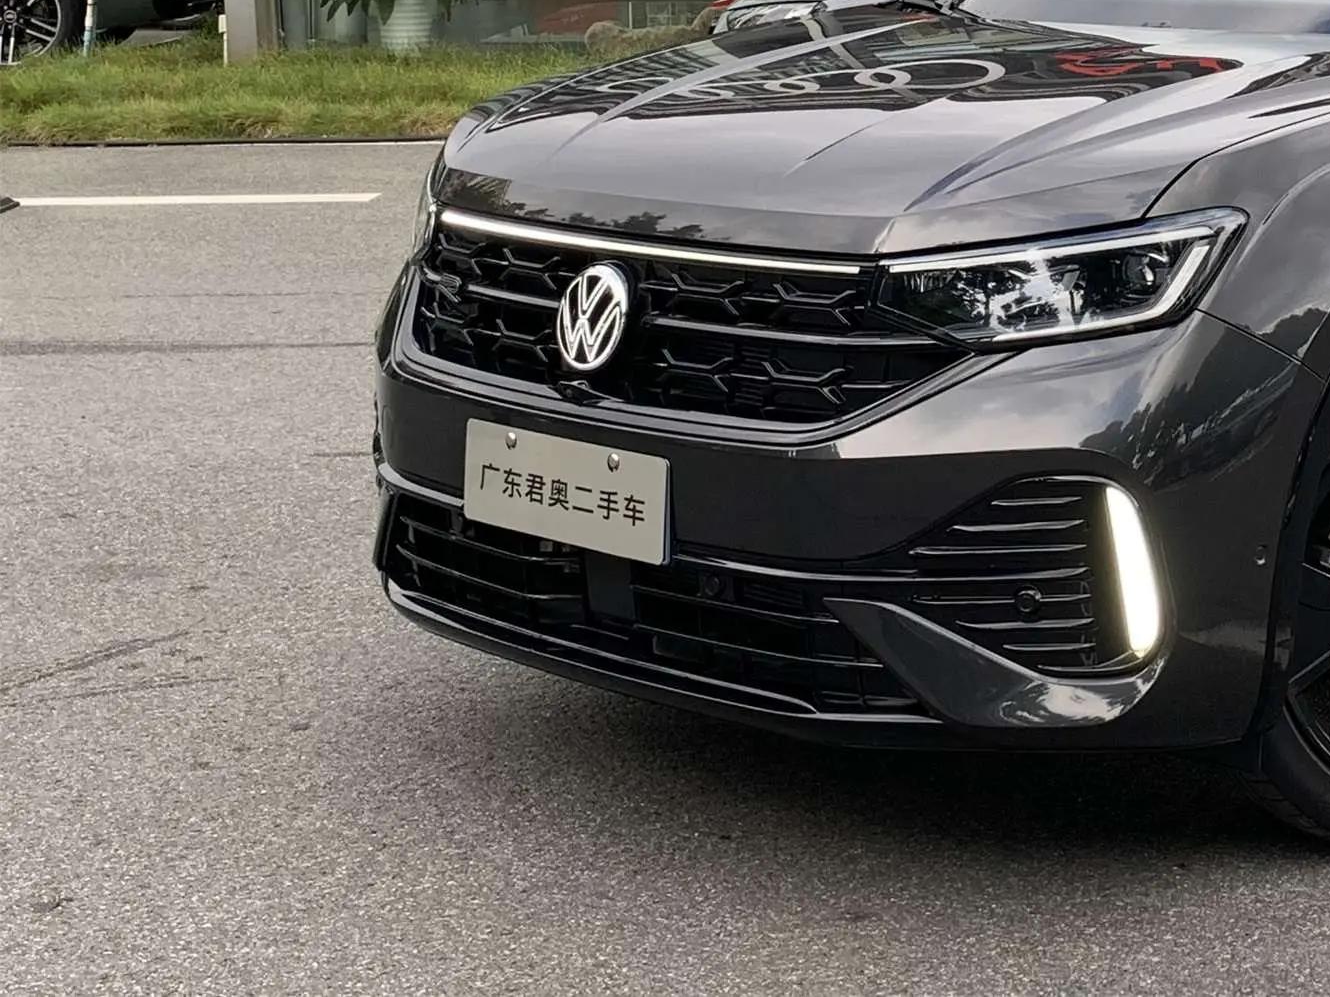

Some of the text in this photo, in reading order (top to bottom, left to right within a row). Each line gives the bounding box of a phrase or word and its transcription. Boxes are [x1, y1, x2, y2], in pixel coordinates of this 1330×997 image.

[480, 463, 645, 527] 广东君奥二手车
